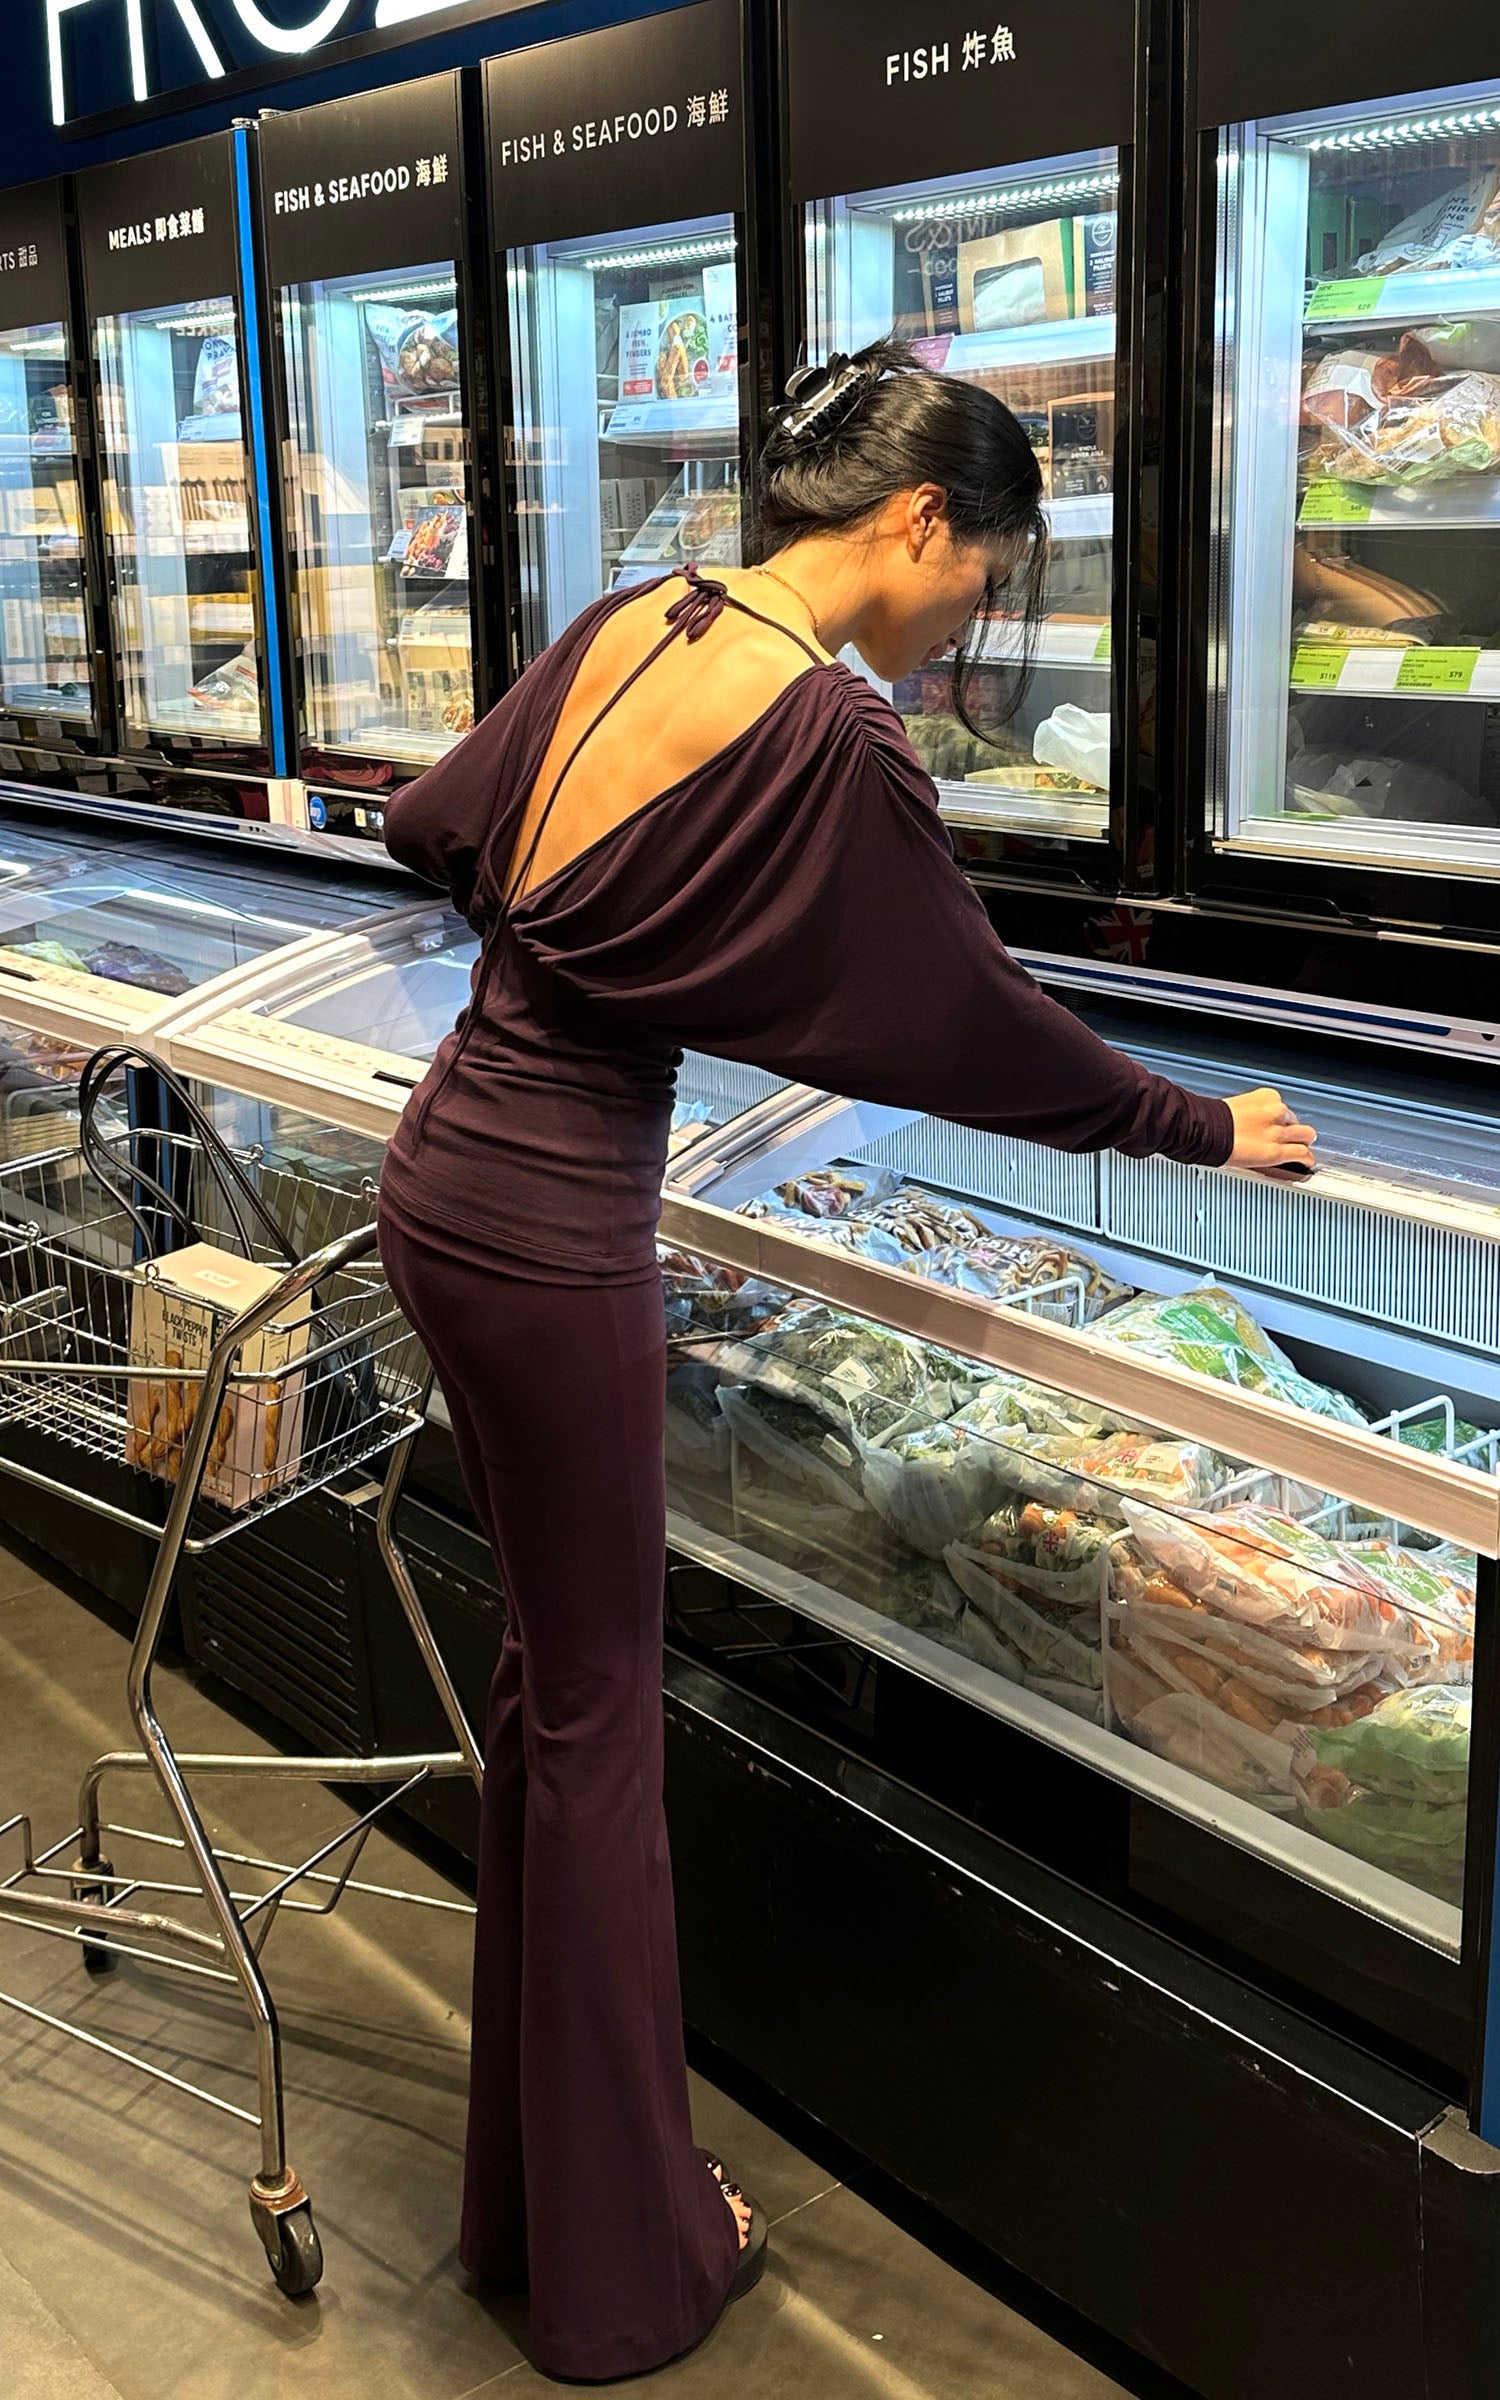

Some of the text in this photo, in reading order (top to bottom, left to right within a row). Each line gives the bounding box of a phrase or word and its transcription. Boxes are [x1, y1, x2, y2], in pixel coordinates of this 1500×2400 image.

[886, 24, 1016, 86] FISH 炸魚
[501, 88, 730, 166] FISH & SEAFOOD 海鮮
[274, 153, 448, 215] FISH & SEAFOOD 海鮮
[18, 244, 38, 268] 甜品
[108, 222, 151, 250] MEALS
[172, 1326, 197, 1347] TWSTS
